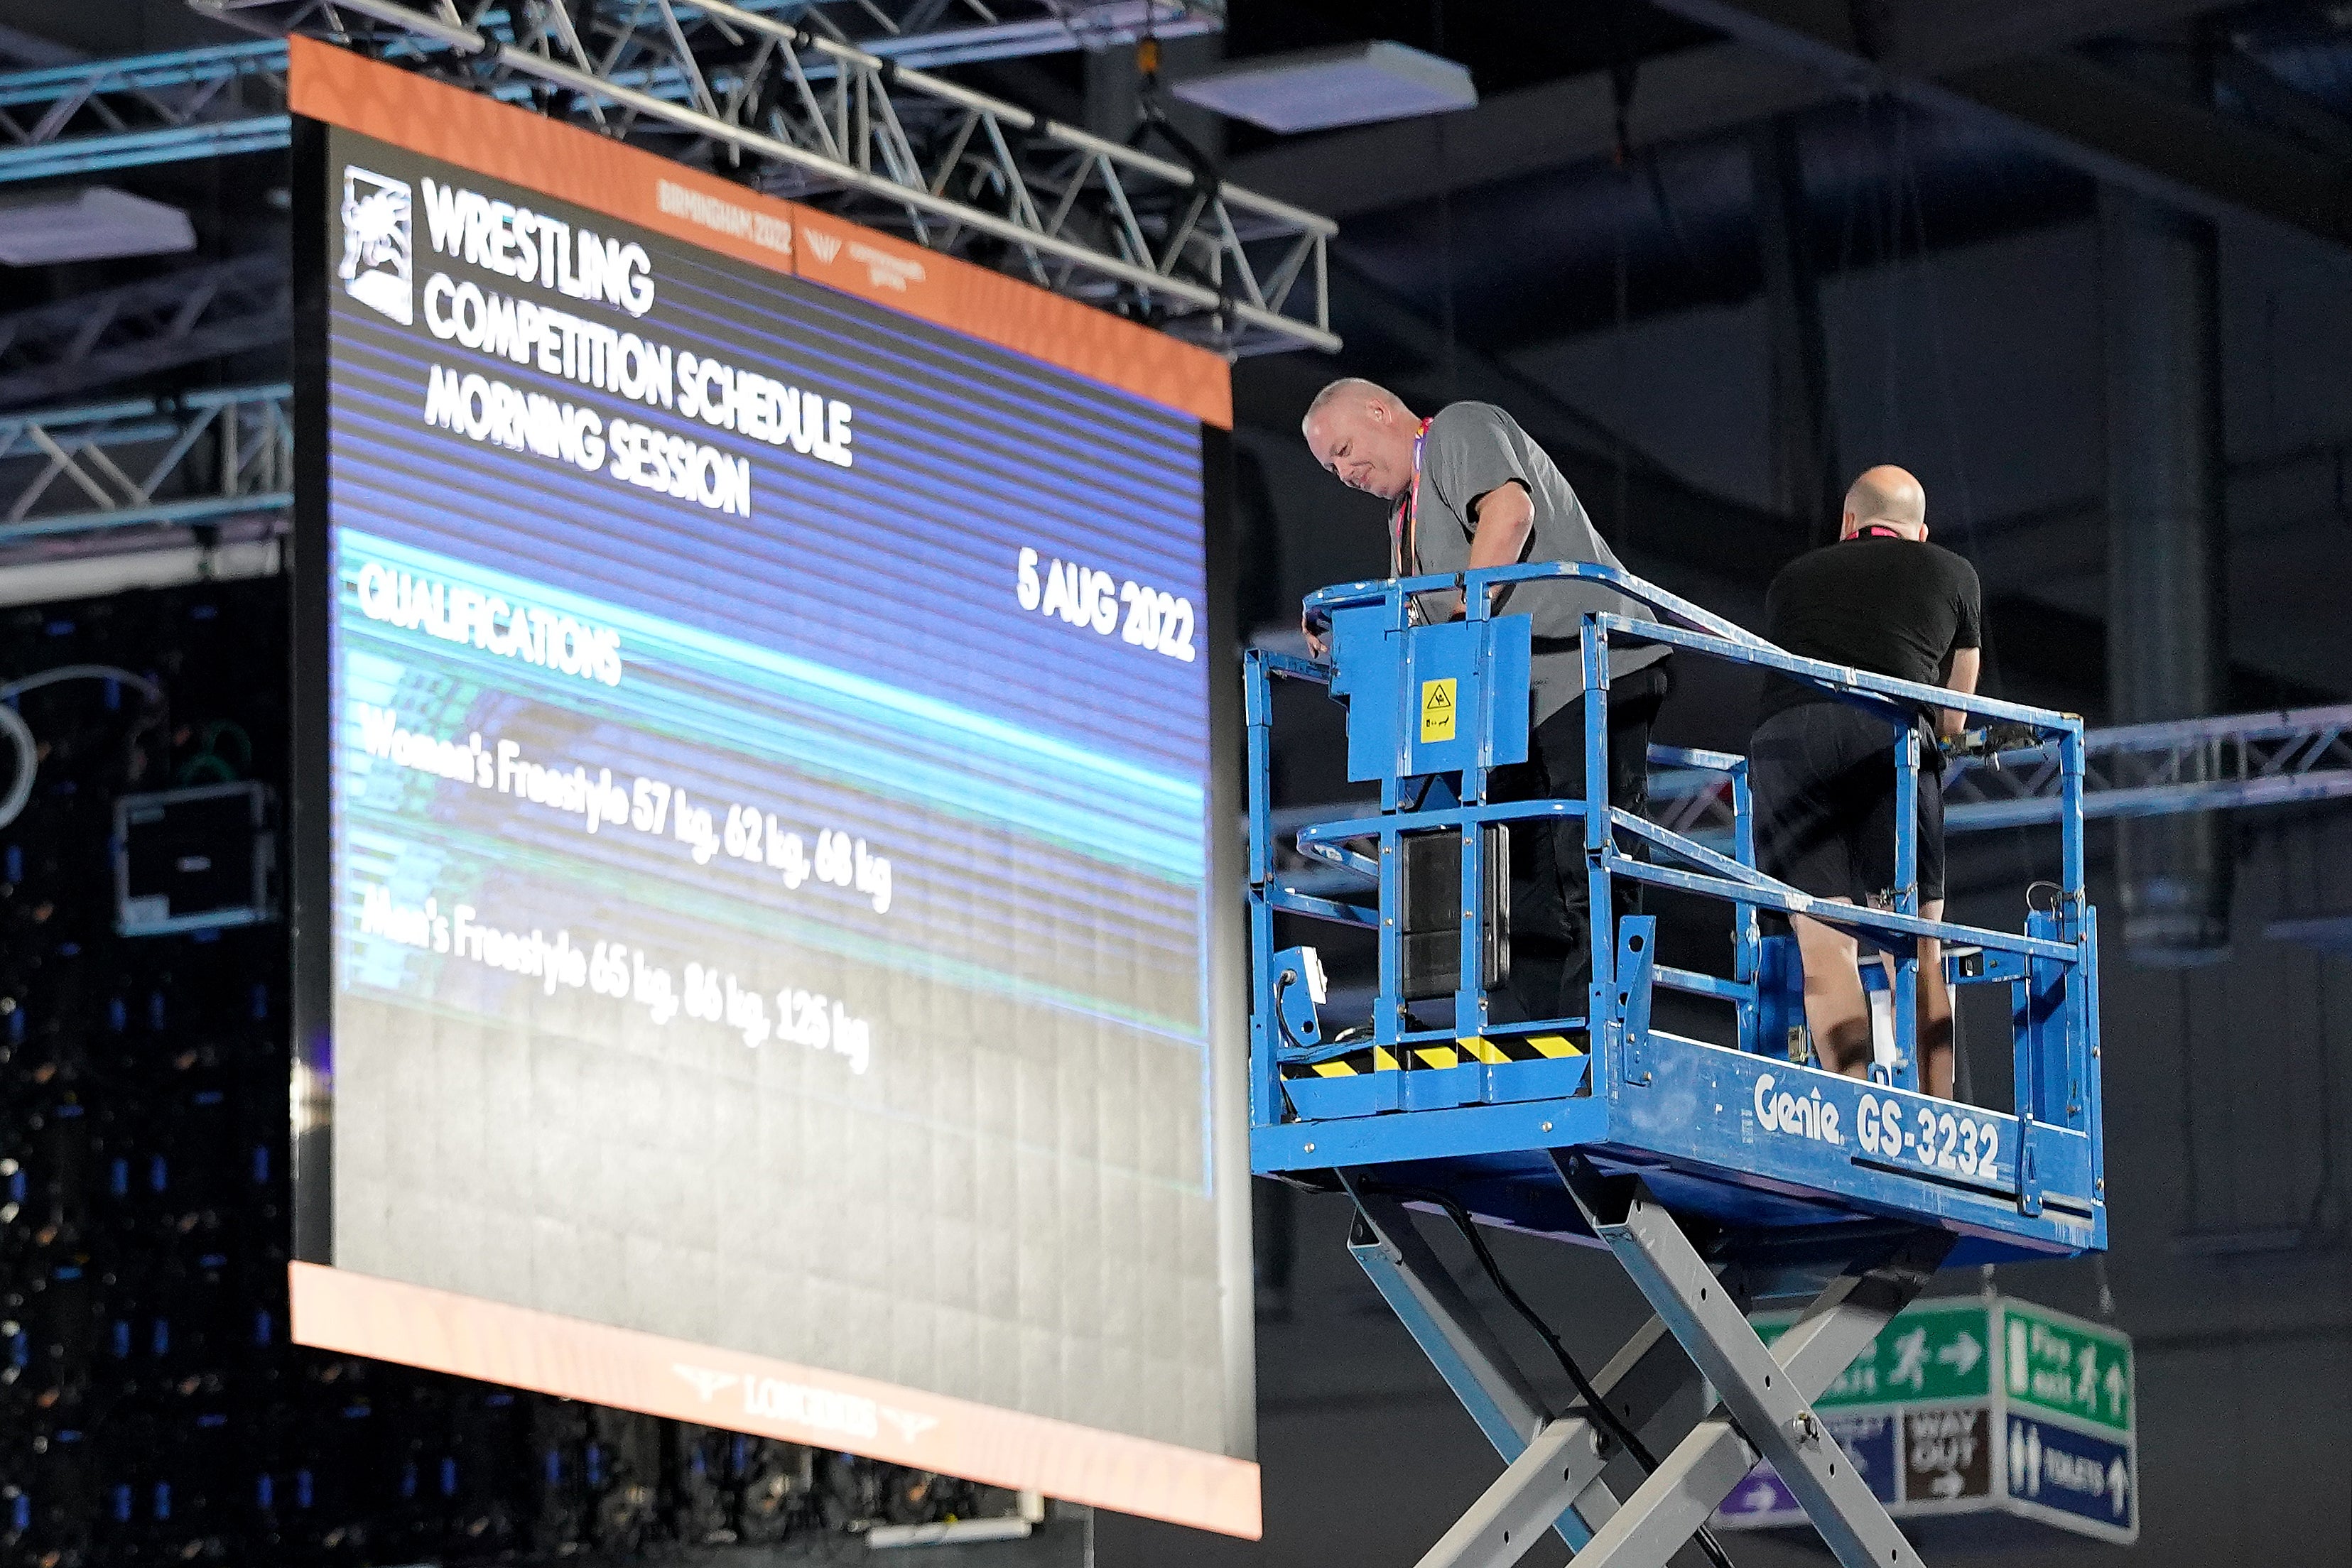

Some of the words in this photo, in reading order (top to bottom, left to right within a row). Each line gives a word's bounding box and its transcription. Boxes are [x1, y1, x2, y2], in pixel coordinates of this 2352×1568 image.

[421, 177, 654, 317] WRESTLING
[423, 364, 606, 472] MORNING
[609, 419, 751, 518] SESSION
[424, 273, 673, 410] COMPETITION
[677, 352, 853, 467] SCHEDULE
[357, 564, 622, 687] QUALIFICATIONS
[1017, 547, 1040, 611] 5
[1043, 558, 1118, 635] AUG
[1120, 581, 1196, 662] 2022
[359, 703, 494, 788] Women's
[497, 739, 629, 834] Freestyle
[632, 777, 671, 834] 57
[674, 788, 720, 865] kg,
[724, 804, 763, 863] 62
[766, 813, 811, 890] kg,
[815, 827, 853, 887] 68
[855, 837, 892, 915] kg
[361, 883, 450, 953] Men's
[453, 904, 587, 995] Freestyle
[590, 939, 630, 998] 65
[633, 948, 679, 1025] kg,
[684, 962, 723, 1021] 86
[725, 973, 771, 1048] kg,
[776, 988, 830, 1050] 125
[833, 1000, 869, 1075] kg
[1755, 1074, 1845, 1145] Genie
[1857, 1094, 1998, 1180] GS-3232
